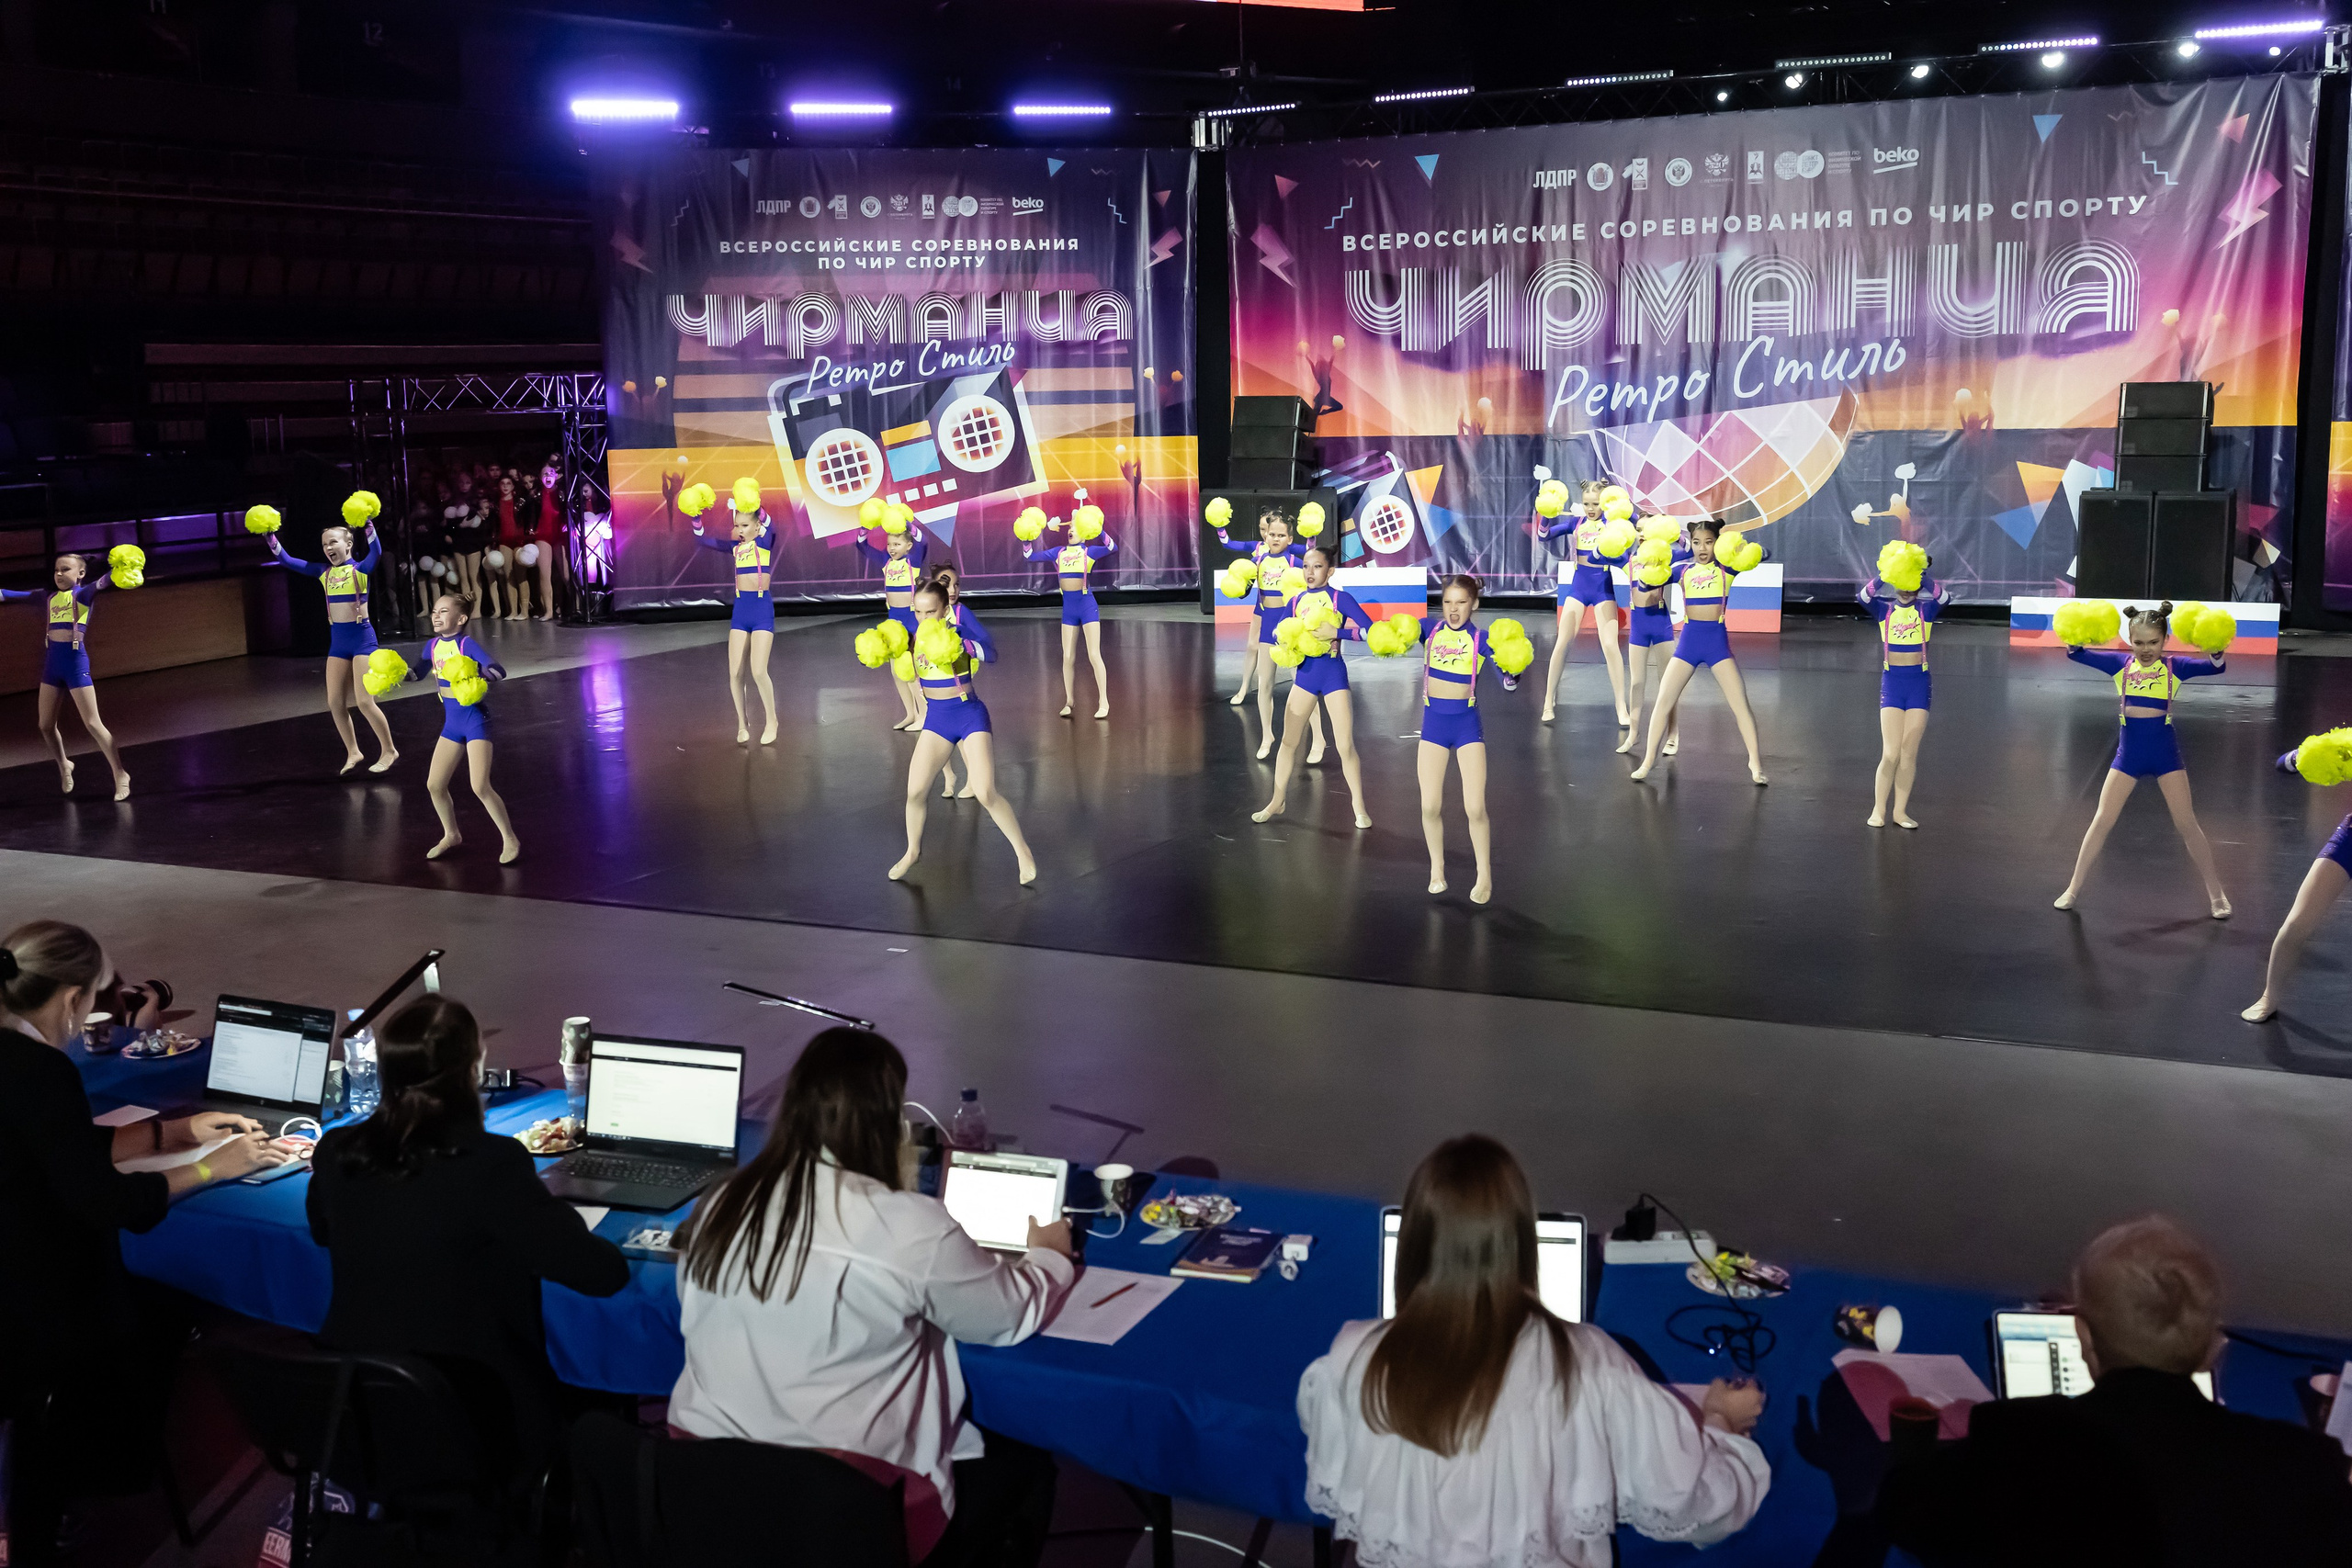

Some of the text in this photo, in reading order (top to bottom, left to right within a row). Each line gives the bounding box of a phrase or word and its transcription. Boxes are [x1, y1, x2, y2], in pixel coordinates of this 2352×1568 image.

[1873, 146, 1919, 164] beko
[1533, 169, 1577, 189] ЛДПР
[755, 199, 791, 215] ЛДПР
[1012, 197, 1044, 209] beko
[1342, 195, 2148, 252] ВСЕРОССИЙСКИЕ СОРЕВНОВАНИЯ ПО ЧИР СПОРТУ
[719, 237, 1079, 254] ВСЕРОССИЙСКИЕ СОРЕВНОВАНИЯ
[818, 255, 986, 270] ПО ЧИР СПОРТУ
[806, 339, 1015, 394] Ретро Стиль
[1547, 334, 1907, 428] Ретро Стиль
